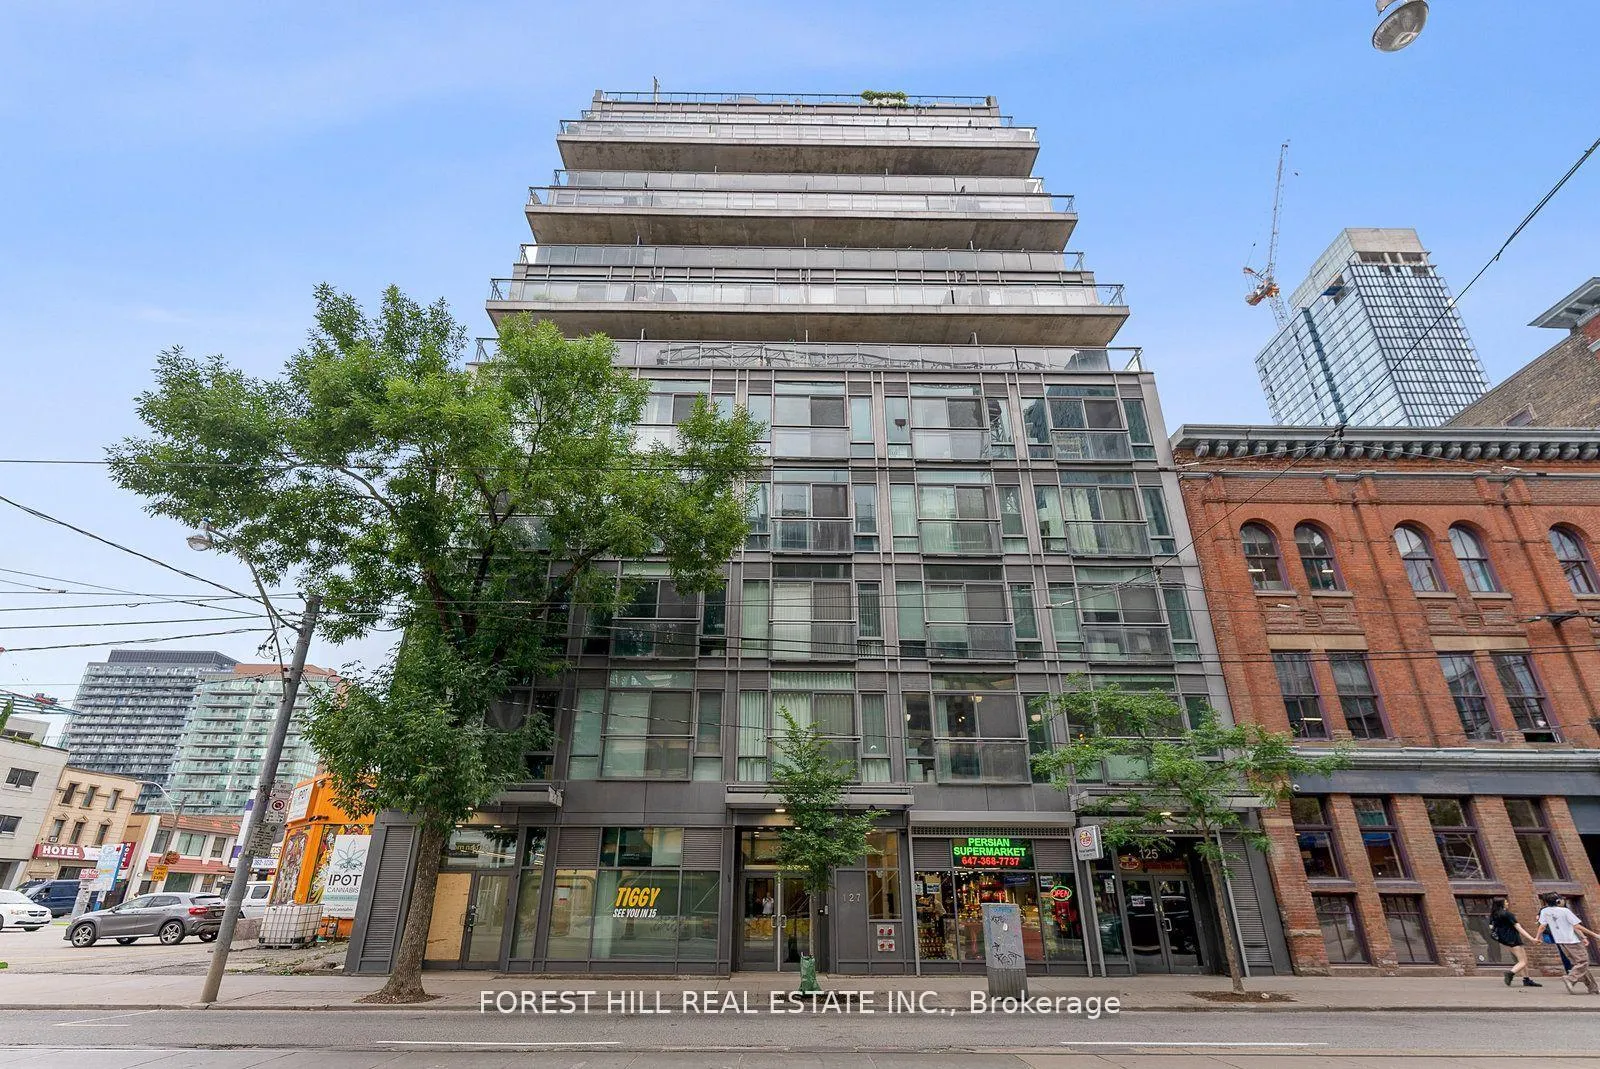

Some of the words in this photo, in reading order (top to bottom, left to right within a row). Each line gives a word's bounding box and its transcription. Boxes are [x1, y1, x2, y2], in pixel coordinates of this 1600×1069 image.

[968, 837, 1010, 847] PERSIAN
[42, 845, 80, 856] HOTEL
[953, 847, 1026, 857] SUPERMARKET
[1139, 848, 1159, 859] 125
[961, 856, 1020, 866] 647-368-7737
[328, 874, 361, 886] IPOT
[326, 886, 359, 894] CANNABIS
[1053, 888, 1070, 898] OPEN
[615, 887, 661, 907] TIGGY
[843, 893, 861, 902] 127
[613, 908, 627, 918] SEE
[626, 908, 640, 918] YOU
[640, 908, 649, 918] IN
[648, 908, 658, 918] 15
